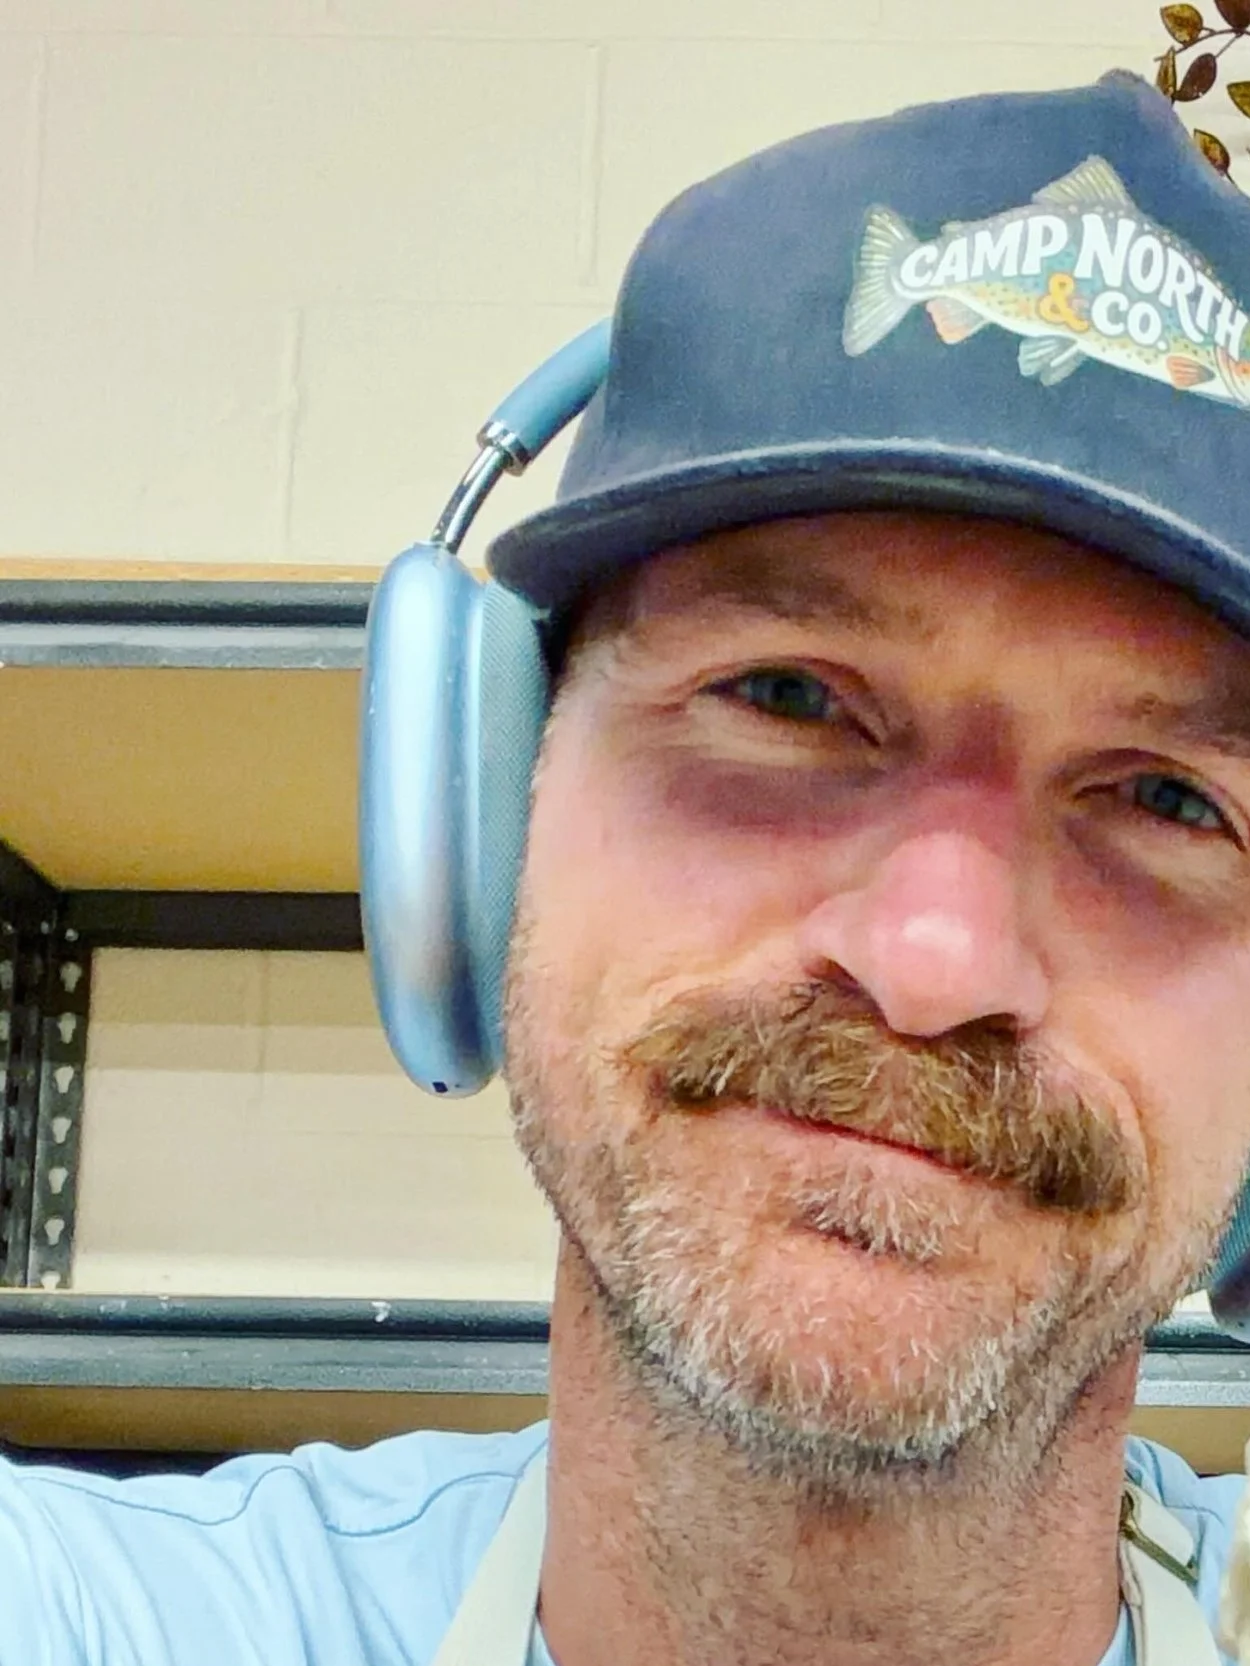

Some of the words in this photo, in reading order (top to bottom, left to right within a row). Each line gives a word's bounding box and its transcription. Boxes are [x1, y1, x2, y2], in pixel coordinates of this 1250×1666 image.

[900, 215, 1068, 288] CAMP
[1074, 213, 1250, 362] NORTH
[1037, 272, 1090, 333] &
[1091, 291, 1168, 351] CO.
